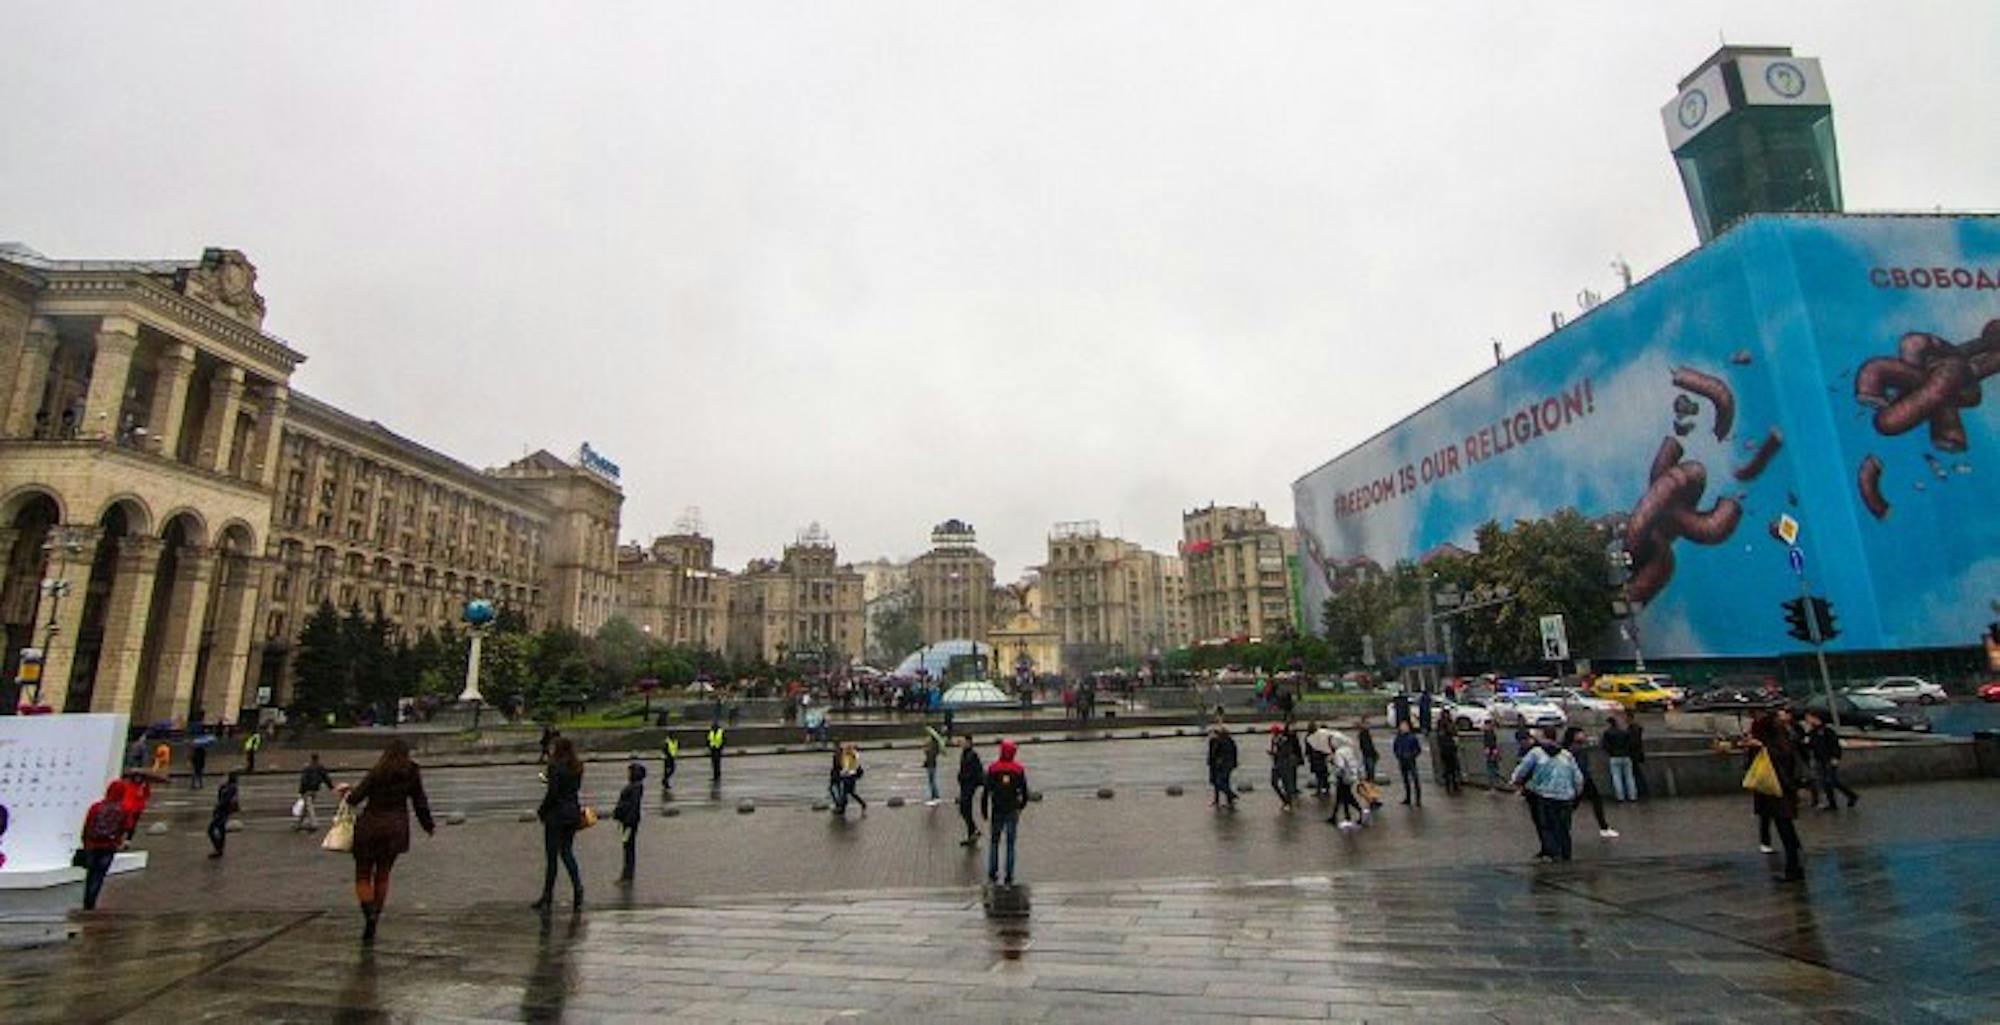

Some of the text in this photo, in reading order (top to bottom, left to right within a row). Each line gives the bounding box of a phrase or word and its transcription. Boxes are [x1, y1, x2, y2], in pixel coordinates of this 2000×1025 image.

[1869, 266, 2000, 291] СВОБОД
[1333, 376, 1594, 520] FREEDOM IS OUR RELIGION!
